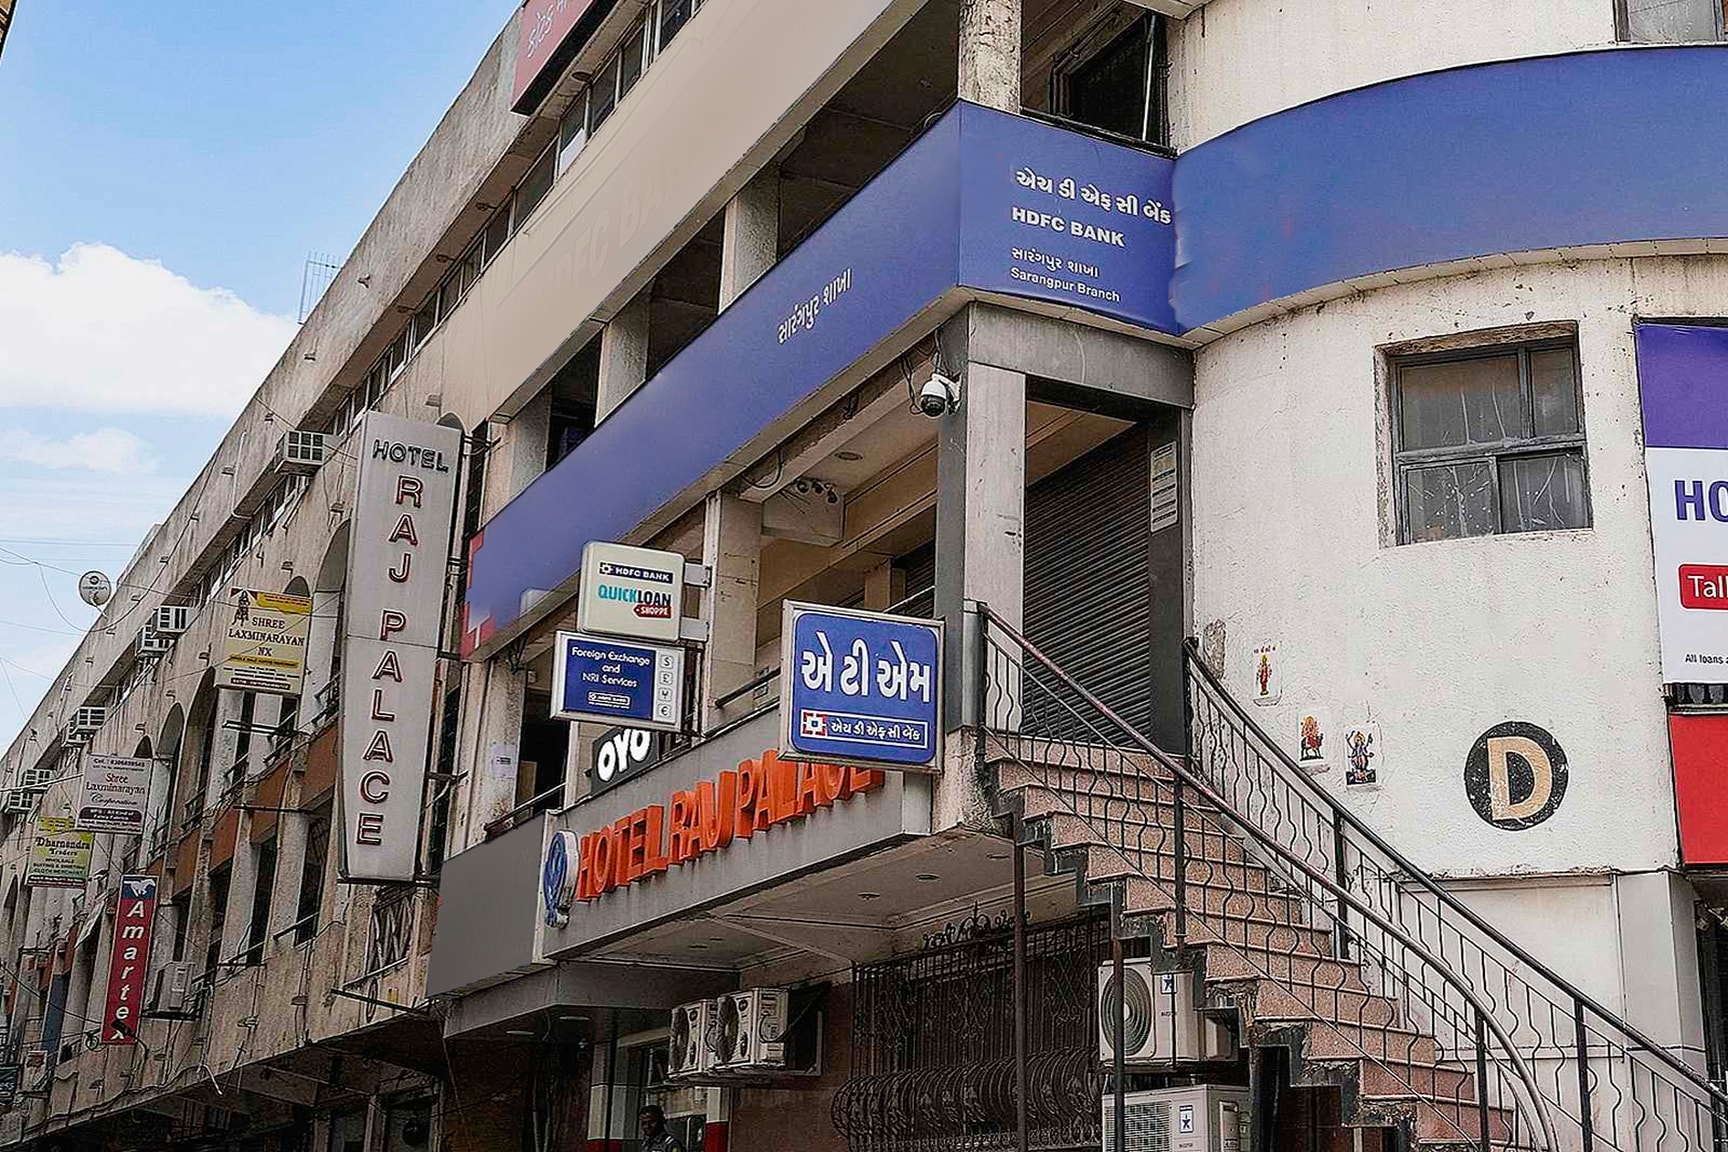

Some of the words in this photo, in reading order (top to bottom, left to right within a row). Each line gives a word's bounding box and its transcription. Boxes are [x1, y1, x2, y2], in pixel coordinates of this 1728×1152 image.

[1016, 167, 1053, 194] એચ
[1058, 177, 1076, 200] ડી
[1116, 195, 1138, 216] સી
[1011, 206, 1065, 232] HDFC
[1070, 221, 1127, 248] BANK
[1011, 247, 1062, 271] સારંગપુર
[1010, 267, 1075, 291] Sarangpur
[1077, 282, 1121, 302] Branch
[778, 294, 821, 344] સારંગપુર
[372, 439, 449, 473] HOTEL
[388, 474, 424, 583] RAJ
[615, 567, 642, 577] HDFC
[643, 571, 671, 582] BANK
[228, 628, 305, 646] LAXMINARAYAN
[252, 616, 286, 630] SHREE
[571, 646, 607, 660] Foreign
[608, 650, 650, 666] Exchange
[601, 663, 621, 674] and
[840, 638, 869, 697] ટી
[877, 640, 932, 703] એમ
[1685, 653, 1697, 663] All
[1700, 654, 1724, 665] loans
[601, 674, 638, 688] Services
[355, 609, 407, 846] PALACE
[597, 728, 651, 782] OYO
[1486, 735, 1552, 821] D
[575, 804, 667, 903] HOTEL
